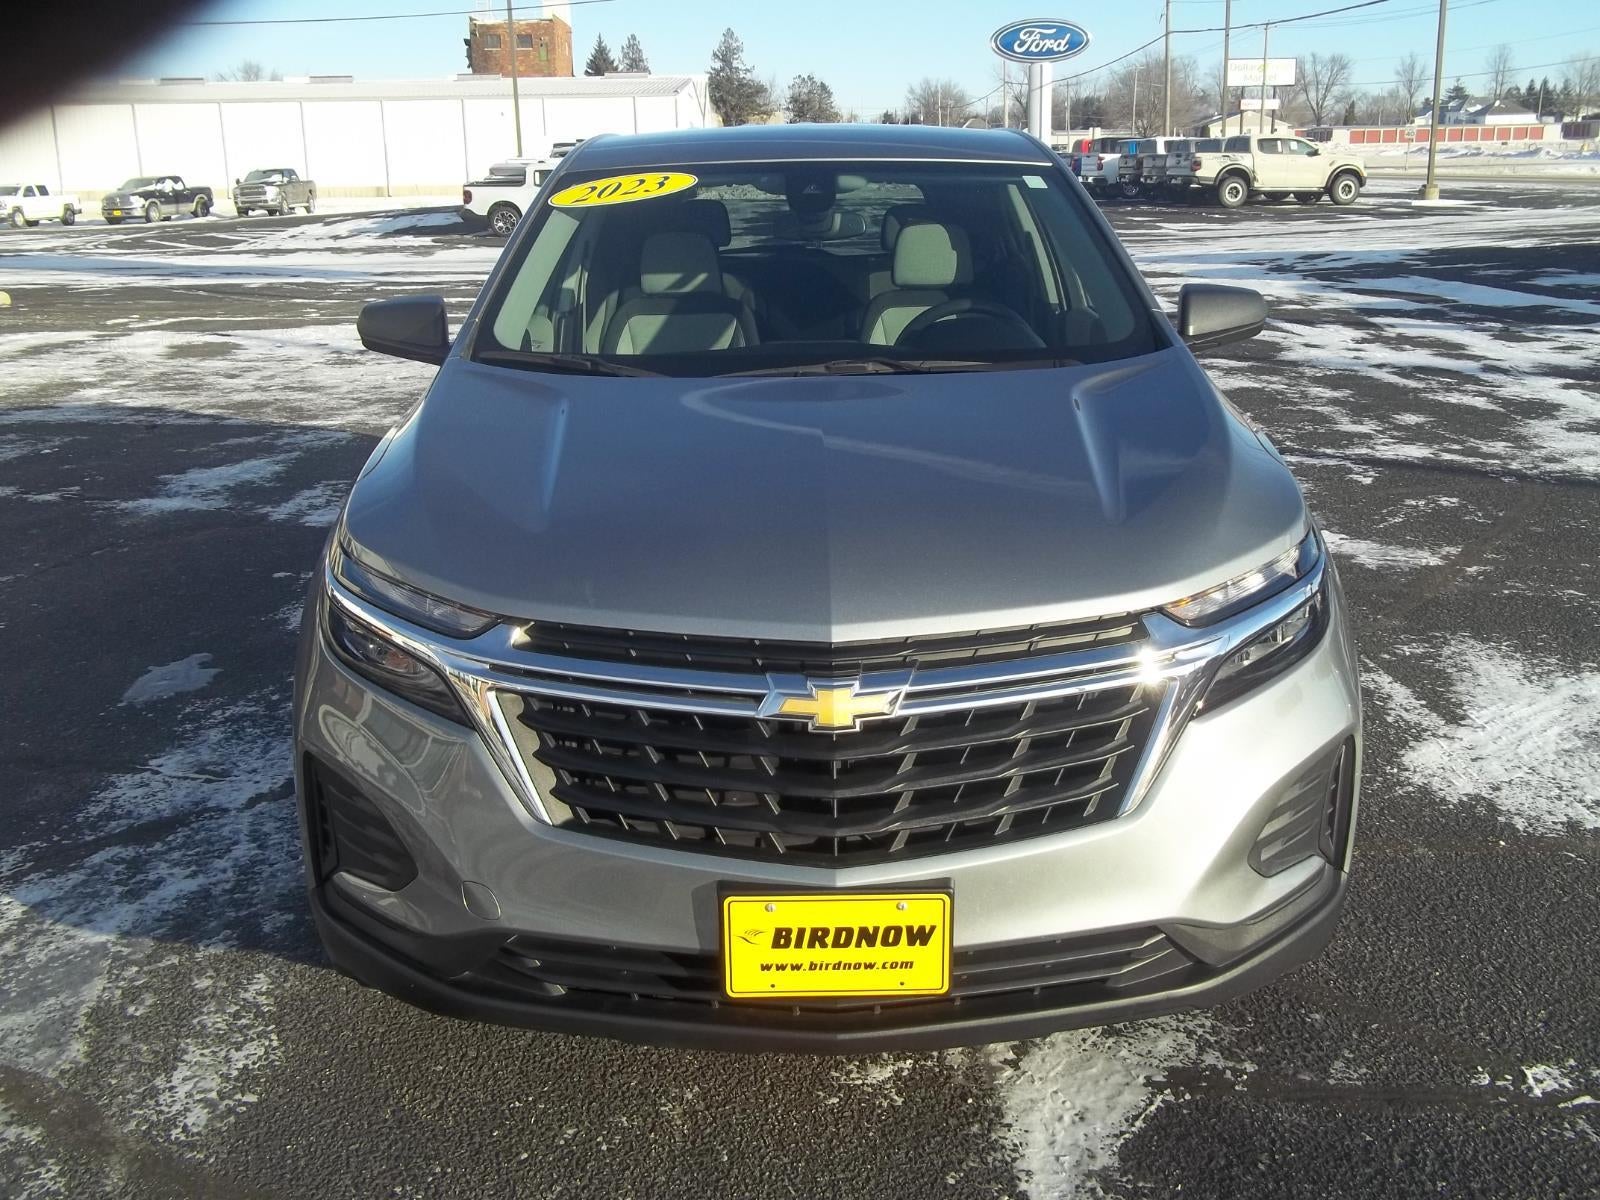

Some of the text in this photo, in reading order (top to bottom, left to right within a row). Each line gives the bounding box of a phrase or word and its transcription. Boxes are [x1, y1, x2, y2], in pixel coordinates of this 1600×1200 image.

[1013, 28, 1071, 53] Ford
[1243, 73, 1277, 82] Maret
[571, 175, 670, 204] 2023
[771, 925, 937, 949] BIRDNOW
[760, 960, 914, 972] www.birdnow.com
